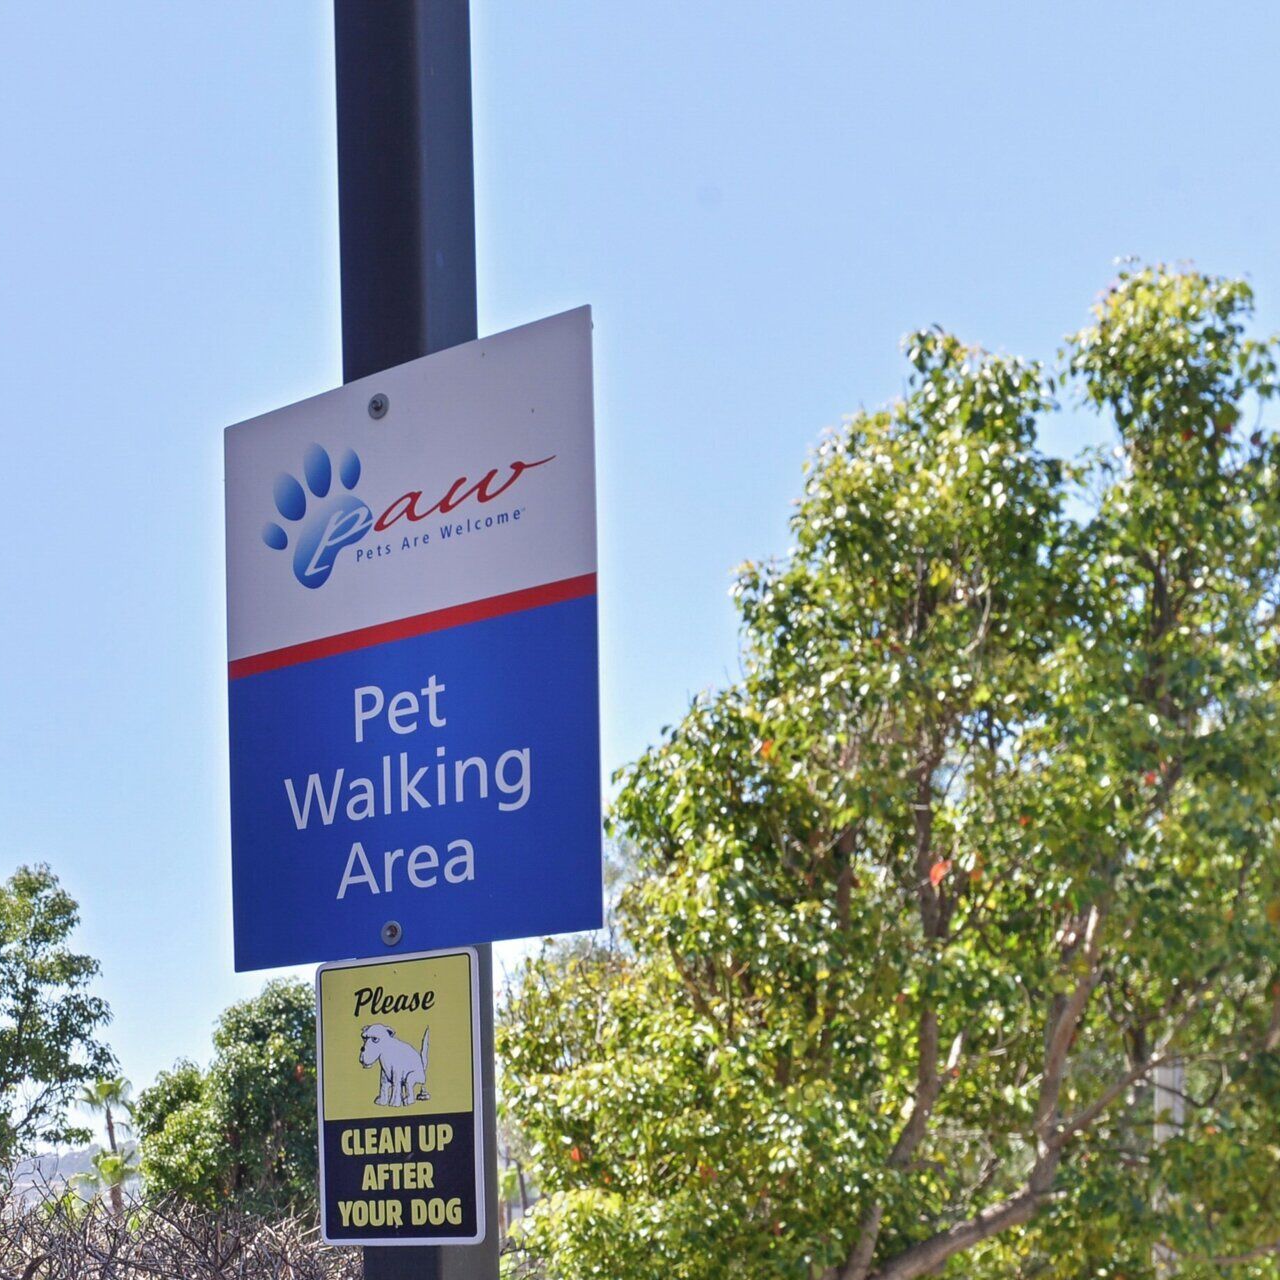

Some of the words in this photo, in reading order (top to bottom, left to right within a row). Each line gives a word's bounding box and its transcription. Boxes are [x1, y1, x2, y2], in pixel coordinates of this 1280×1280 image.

[356, 543, 392, 562] Pets
[401, 533, 430, 550] Are
[440, 507, 521, 539] Welcome
[354, 674, 447, 743] Pet
[283, 746, 532, 830] Walking
[336, 838, 476, 900] Area
[354, 985, 435, 1017] Please
[340, 1126, 412, 1156] CLEAN
[418, 1124, 453, 1152] UP
[361, 1161, 434, 1191] AFTER
[338, 1199, 403, 1227] YOUR
[410, 1197, 462, 1226] DOG
